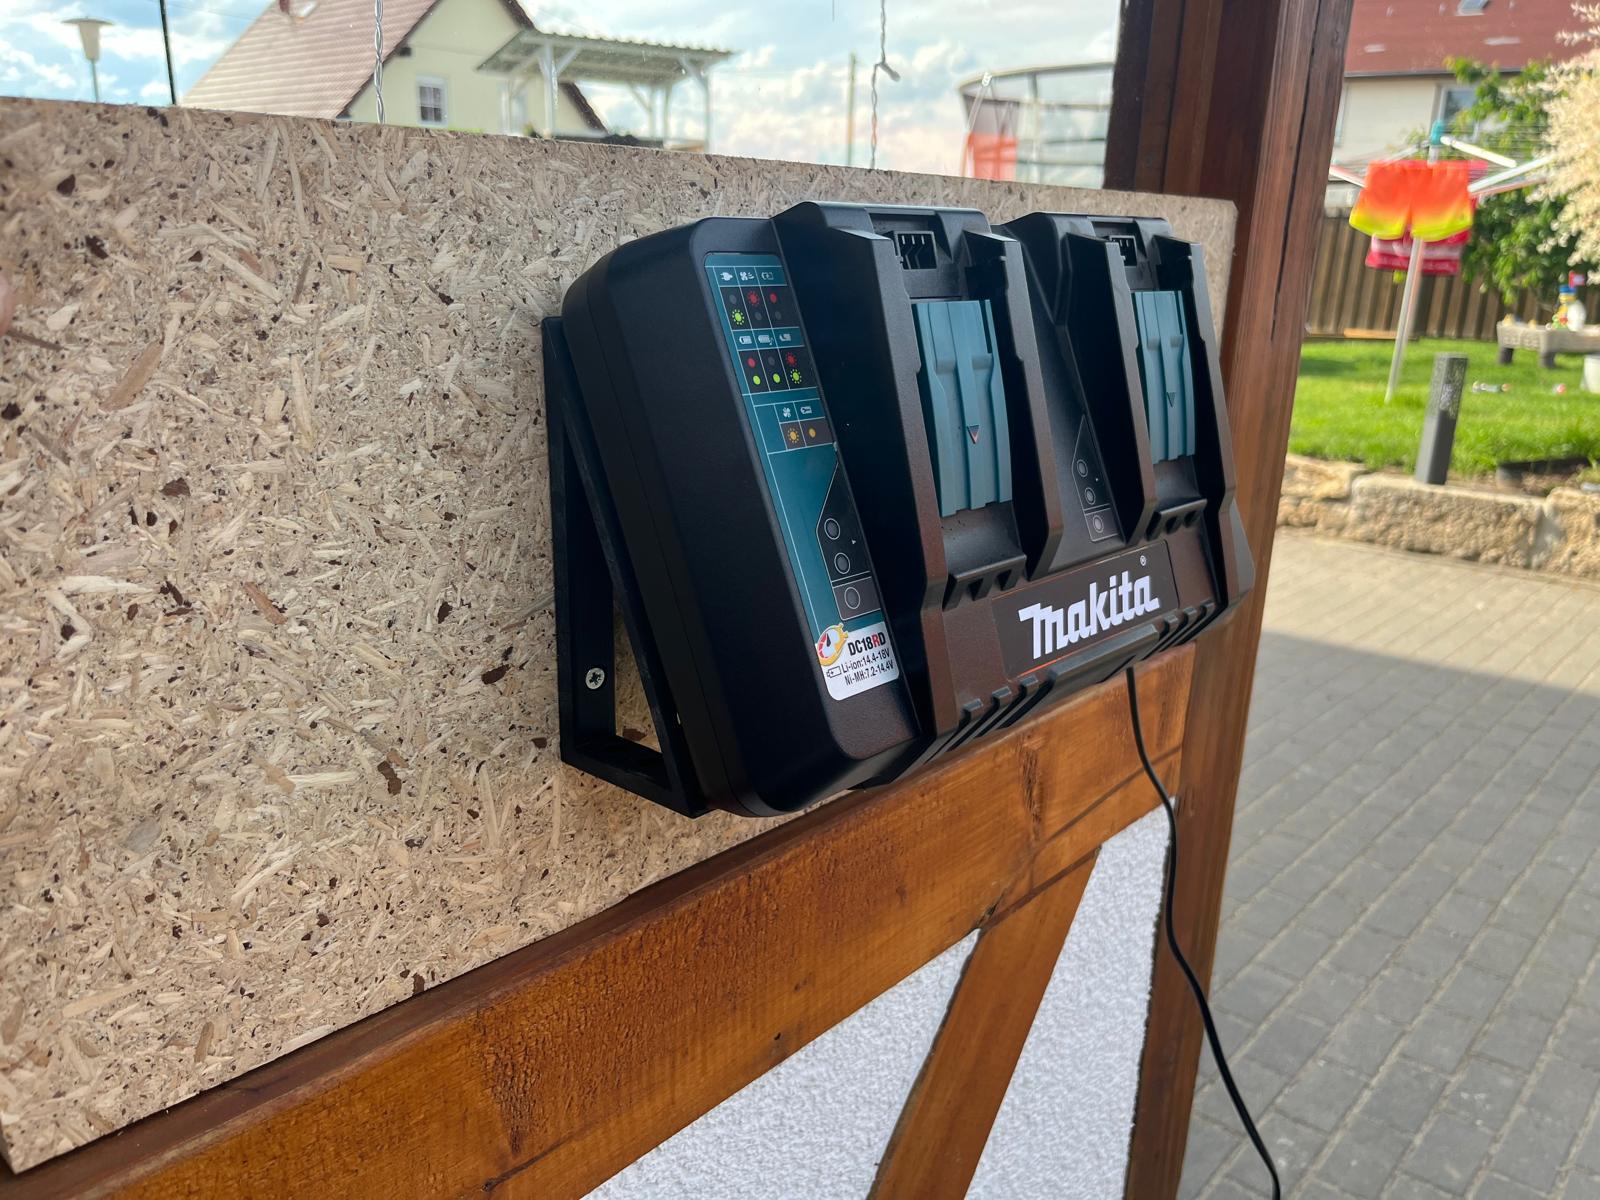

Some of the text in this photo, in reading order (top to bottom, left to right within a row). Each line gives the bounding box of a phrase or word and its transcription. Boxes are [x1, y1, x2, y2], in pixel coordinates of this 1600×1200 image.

[848, 632, 886, 656] DC18RD
[841, 648, 890, 673] Li-ion:14.4-18V
[845, 660, 894, 686] Ni-MH:7.2-14.4V
